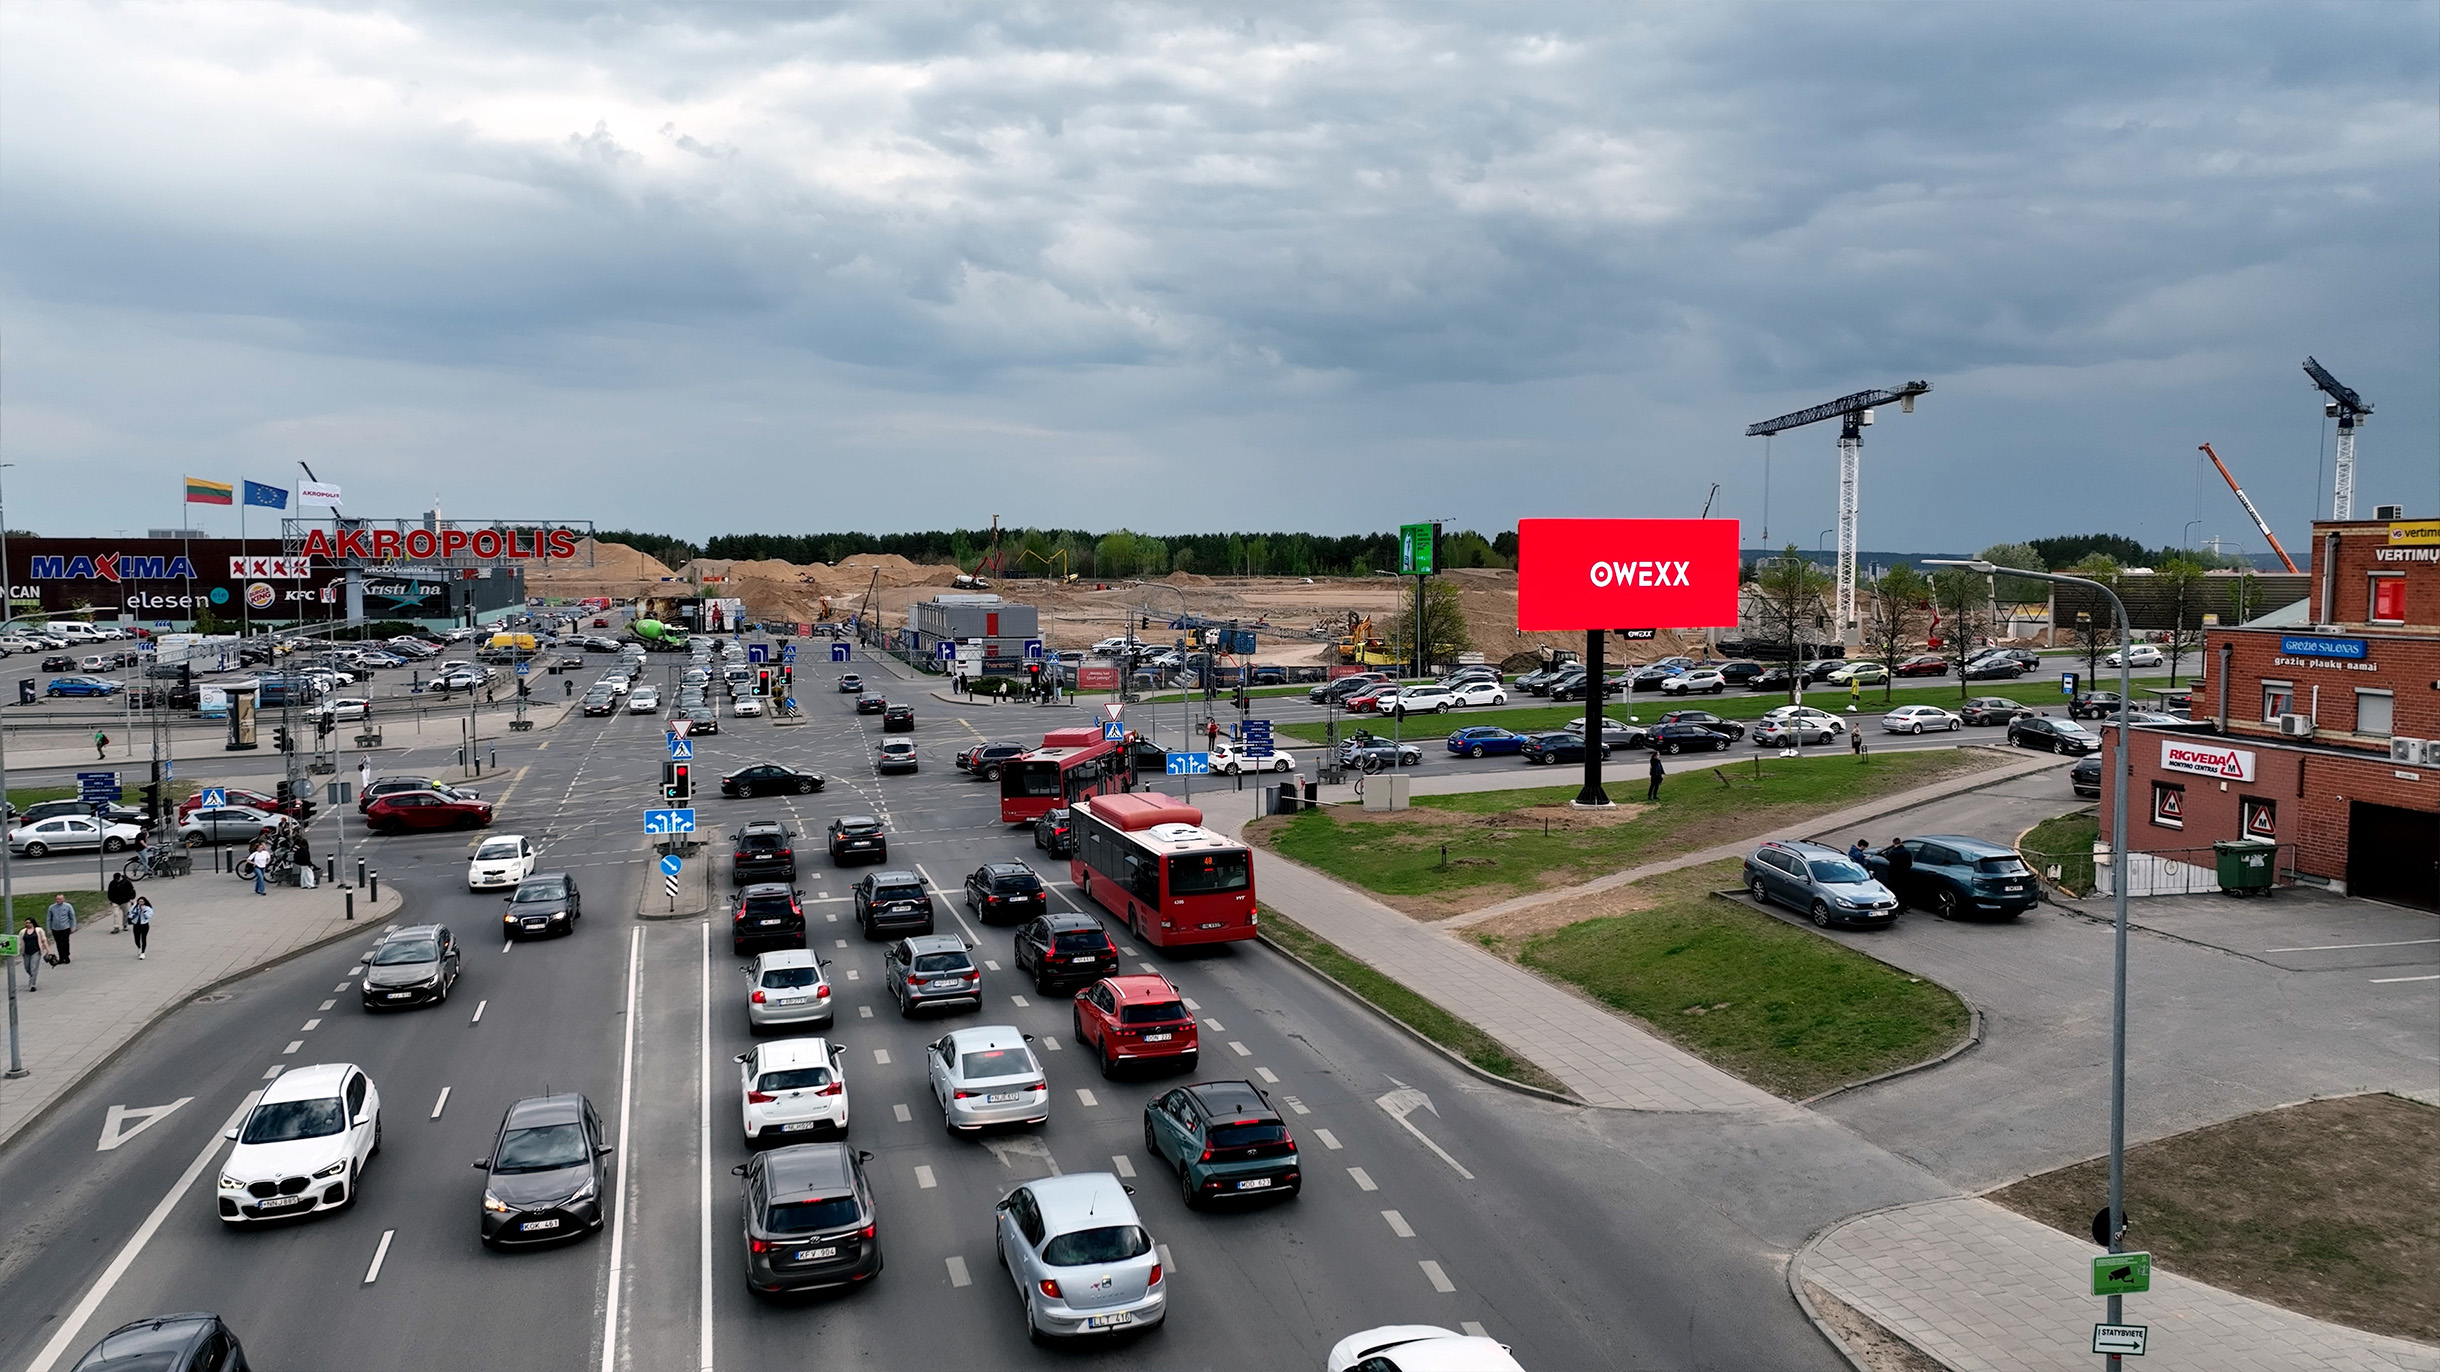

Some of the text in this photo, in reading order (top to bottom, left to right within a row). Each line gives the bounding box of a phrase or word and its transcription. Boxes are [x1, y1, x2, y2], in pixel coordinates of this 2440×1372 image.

[303, 490, 340, 498] AKROPOLIS
[301, 528, 577, 560] AKROPOLIS
[2375, 548, 2440, 564] VERTIMŲ
[30, 551, 198, 582] MAXIMA
[1589, 560, 1690, 588] OWEXX
[9, 585, 40, 598] CAN
[284, 590, 315, 600] KFC
[126, 591, 209, 609] elesen
[2285, 640, 2318, 652] GROŽIO
[2347, 662, 2378, 672] namai
[2169, 748, 2227, 767] RIGVEDA
[2193, 764, 2218, 773] CENTRAS
[2227, 764, 2236, 773] M
[2168, 802, 2176, 811] M
[2258, 818, 2267, 828] M
[524, 1222, 540, 1230] KOK
[799, 1250, 817, 1260] KFV
